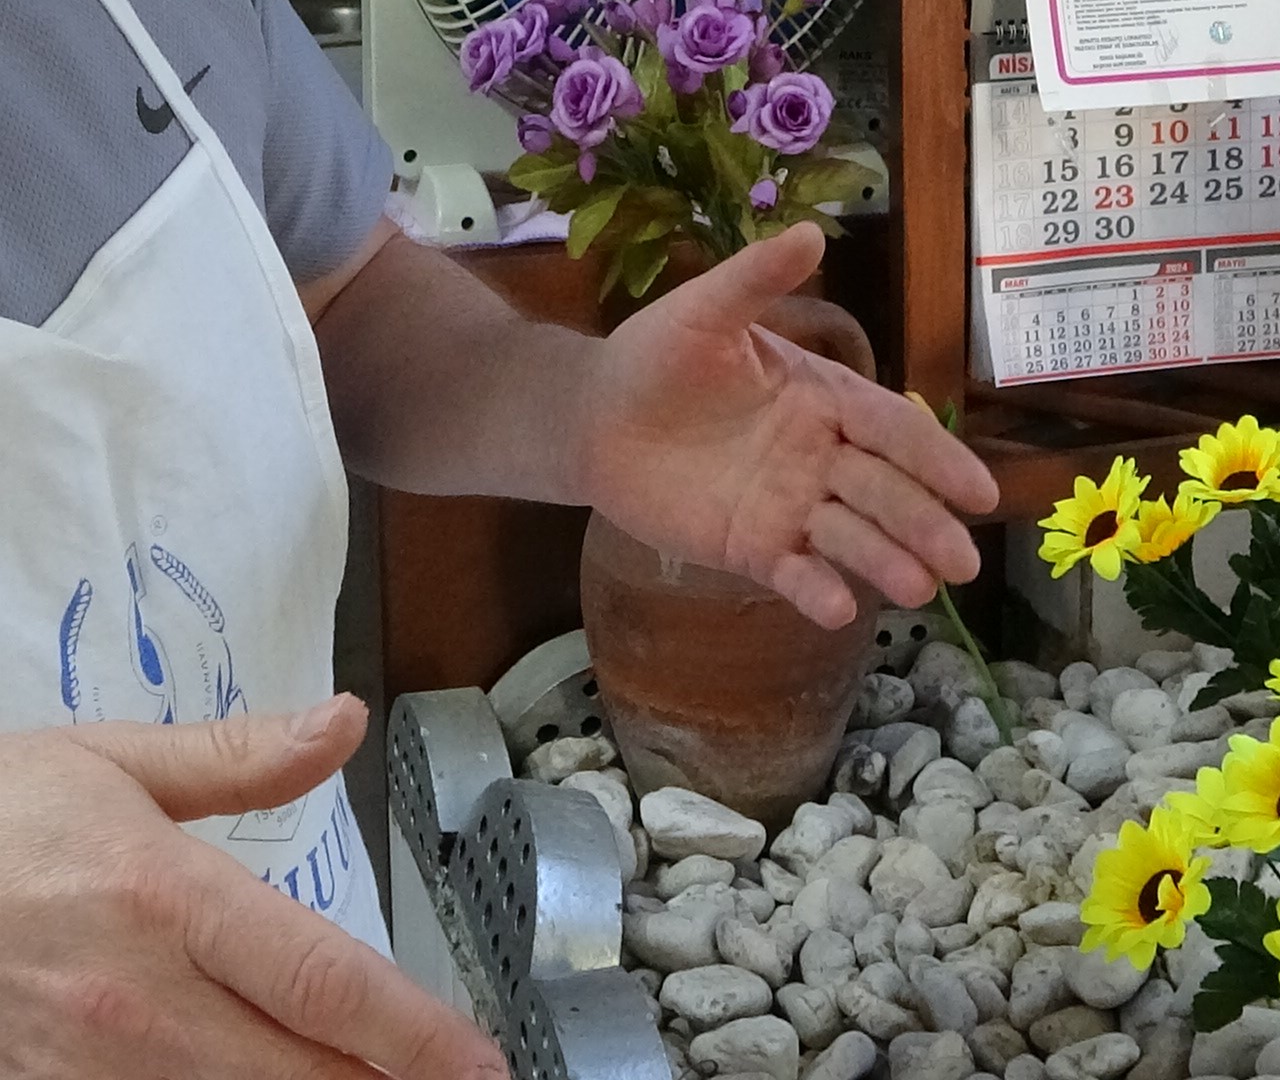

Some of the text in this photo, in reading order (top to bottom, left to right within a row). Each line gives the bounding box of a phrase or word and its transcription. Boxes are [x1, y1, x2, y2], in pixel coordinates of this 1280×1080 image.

[1115, 124, 1133, 147] 9
[1152, 120, 1188, 144] 10
[1044, 159, 1078, 183] 15
[1098, 154, 1134, 179] 16
[1153, 151, 1189, 175] 17
[1208, 147, 1243, 171] 18
[1043, 189, 1078, 214] 22
[1095, 185, 1133, 209] 23
[1150, 181, 1189, 205] 24
[1205, 176, 1243, 201] 25
[1044, 220, 1079, 245] 29
[1095, 216, 1134, 240] 30
[1004, 280, 1029, 288] MART
[1132, 284, 1189, 300] 1 2 3
[1033, 299, 1189, 325] 4 5 6 7 8 9 10
[1247, 295, 1255, 306] 6
[1272, 292, 1280, 304] 7
[1239, 310, 1255, 322] 13
[1264, 308, 1279, 320] 14
[1026, 314, 1189, 343] 11 12 13 14 15 16 17
[1238, 325, 1255, 337] 20
[1263, 323, 1279, 335] 21
[1026, 330, 1189, 358] 18 19 20 21 22 23 24
[1238, 339, 1255, 352] 27
[1263, 338, 1280, 350] 28
[1026, 345, 1189, 374] 25 26 27 28 29 30 31
